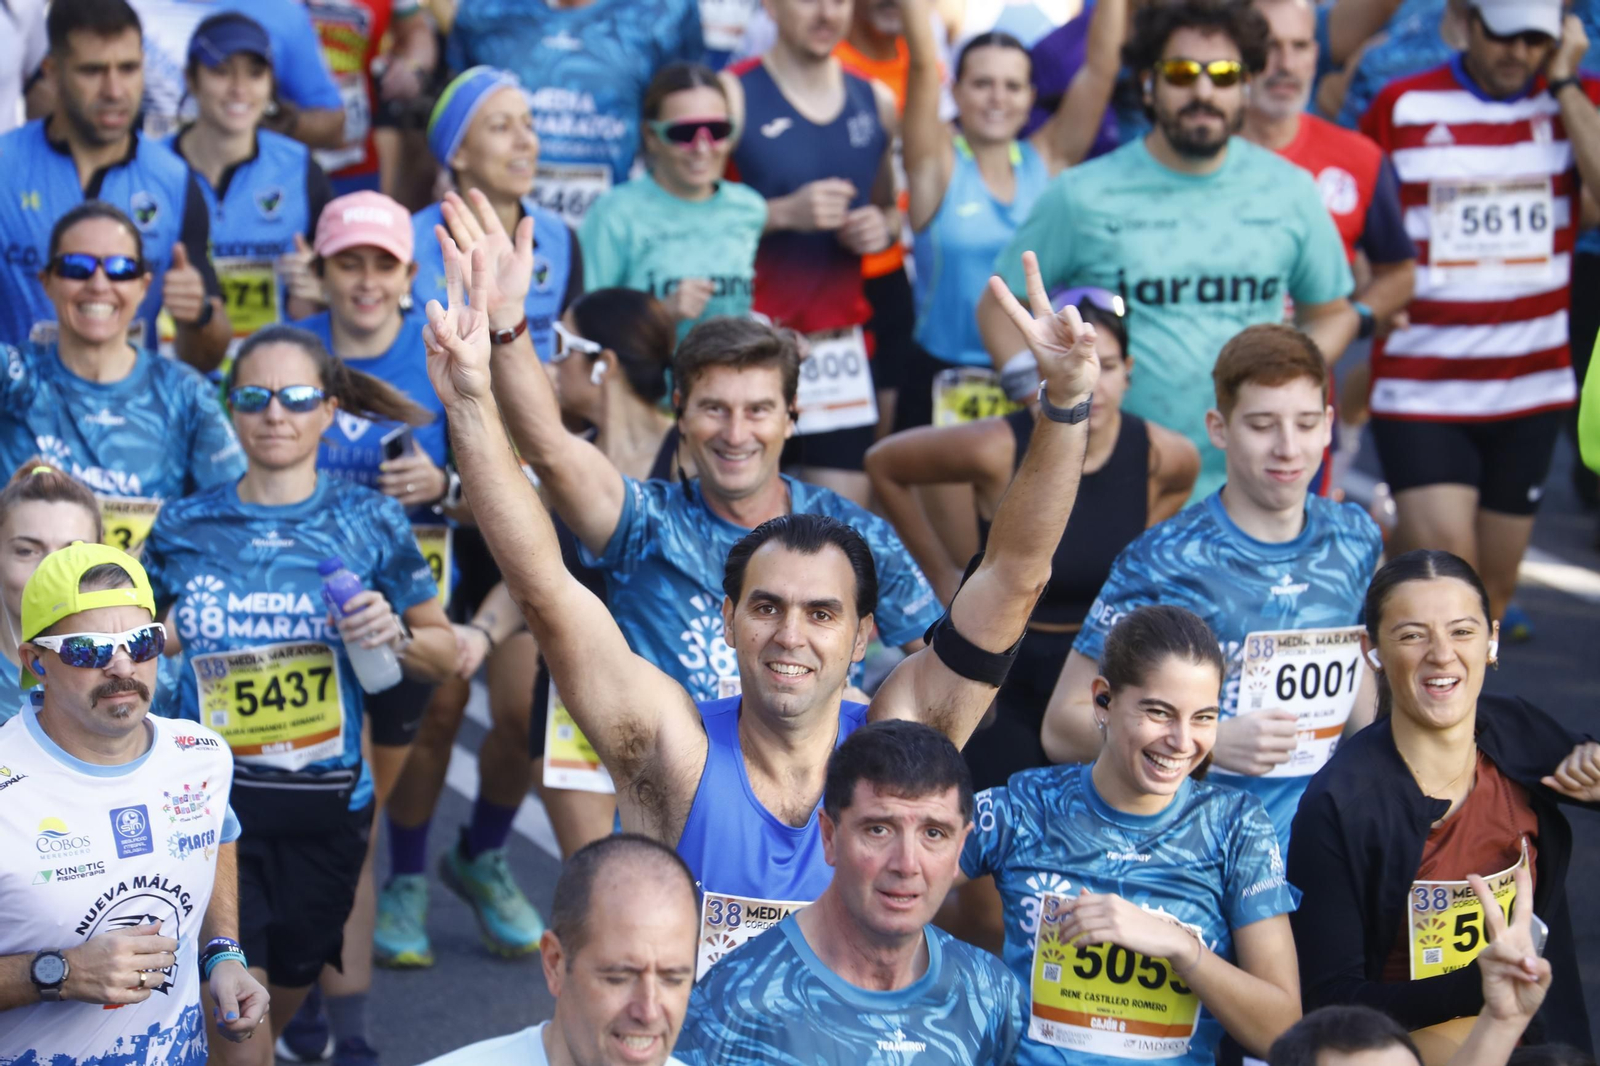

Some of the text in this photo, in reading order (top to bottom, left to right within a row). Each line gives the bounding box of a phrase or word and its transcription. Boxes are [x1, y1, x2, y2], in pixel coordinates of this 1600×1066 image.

[1462, 203, 1547, 235] 5616
[227, 592, 316, 615] MEDIA
[178, 606, 225, 640] 38
[1250, 638, 1275, 660] 38
[201, 658, 228, 680] 38
[228, 652, 265, 668] MEDIA
[234, 666, 332, 717] 5437
[1276, 660, 1358, 701] 6001
[178, 829, 215, 852] PLAFER
[40, 849, 91, 860] MERENDERO
[75, 874, 193, 936] NUEVA MÁLAGA
[1414, 887, 1448, 911] 38
[707, 900, 791, 927] 38 MEDIA
[1060, 988, 1168, 1013] IRENE CASTILLEJO ROMERO
[1090, 1016, 1117, 1032] CAJÓN
[1139, 1039, 1185, 1052] IMDECO
